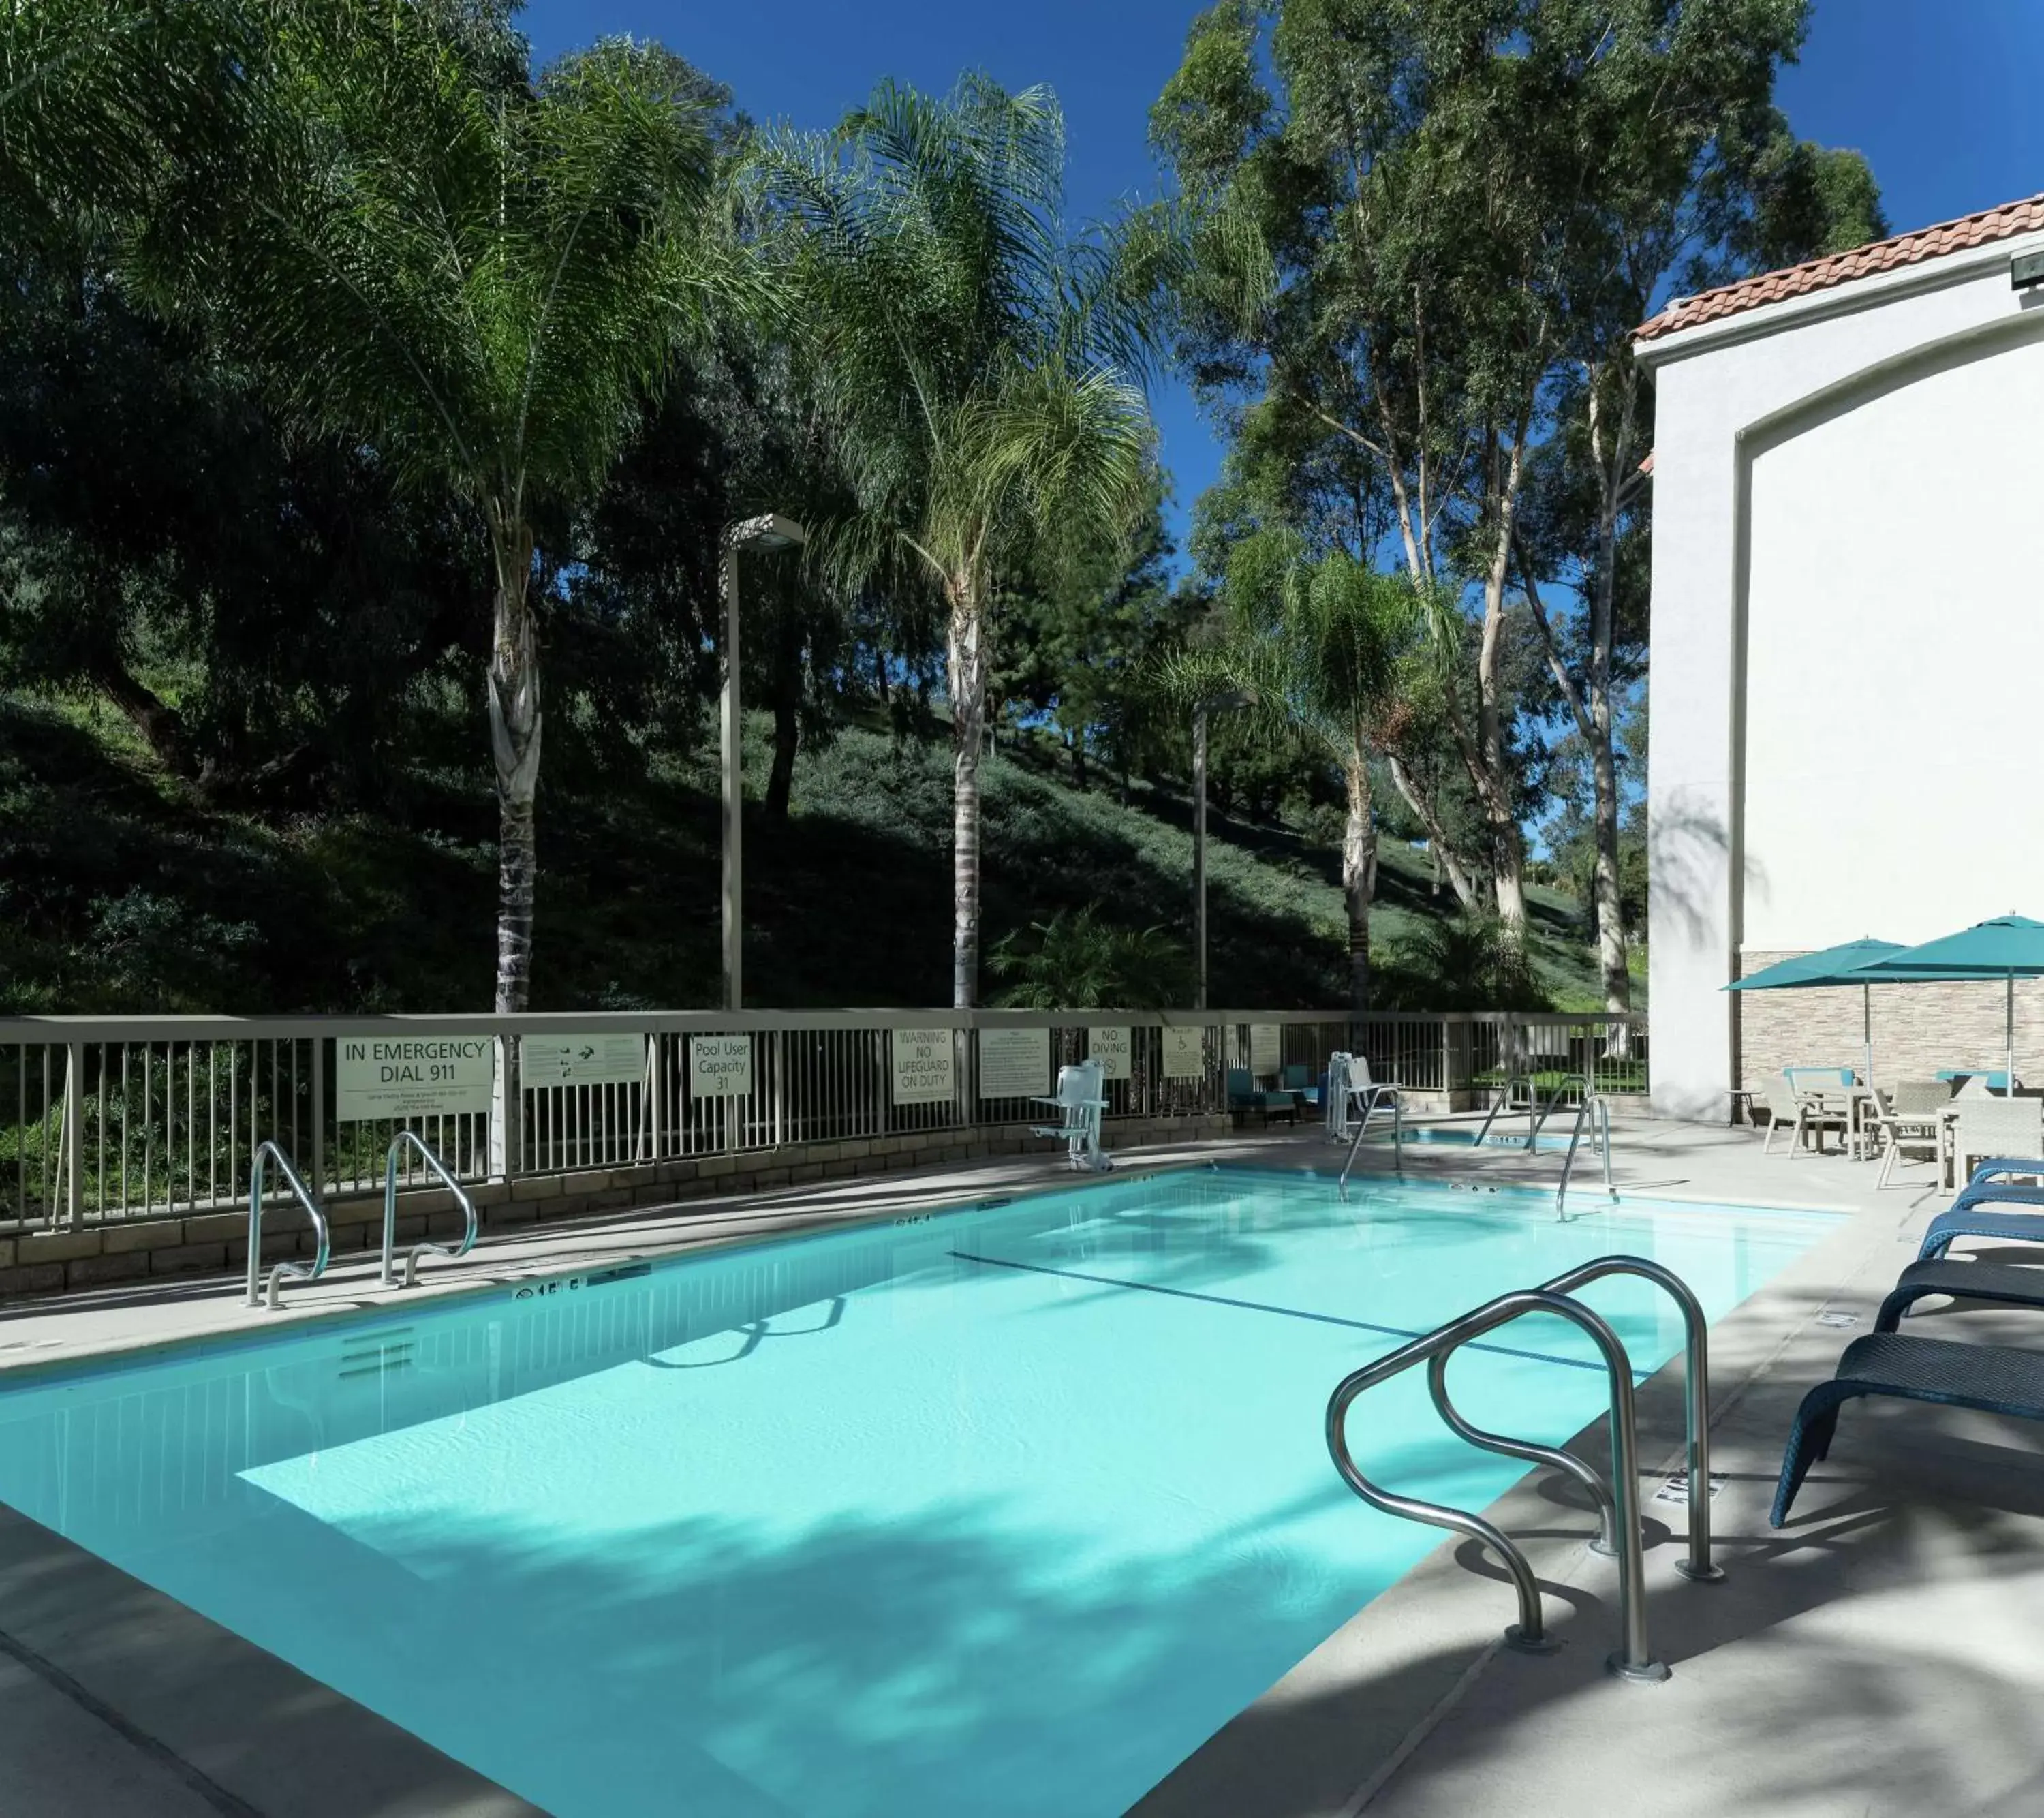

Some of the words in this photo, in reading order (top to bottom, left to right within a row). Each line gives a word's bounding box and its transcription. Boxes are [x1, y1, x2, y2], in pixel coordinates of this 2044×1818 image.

[899, 1030, 946, 1044] WARNING
[1102, 1030, 1118, 1041] NO
[345, 1043, 365, 1060] IN
[374, 1042, 486, 1060] EMERGENCY
[696, 1041, 720, 1056] Pool
[724, 1042, 748, 1056] User
[916, 1046, 931, 1058] NO
[1092, 1042, 1128, 1054] DIVING
[698, 1058, 746, 1077] Capacity
[898, 1059, 949, 1073] LIFEGUARD
[381, 1065, 424, 1083] DIAL
[430, 1064, 455, 1081] 911
[901, 1075, 917, 1088] ON
[920, 1073, 946, 1087] DUTY
[717, 1077, 728, 1090] 31
